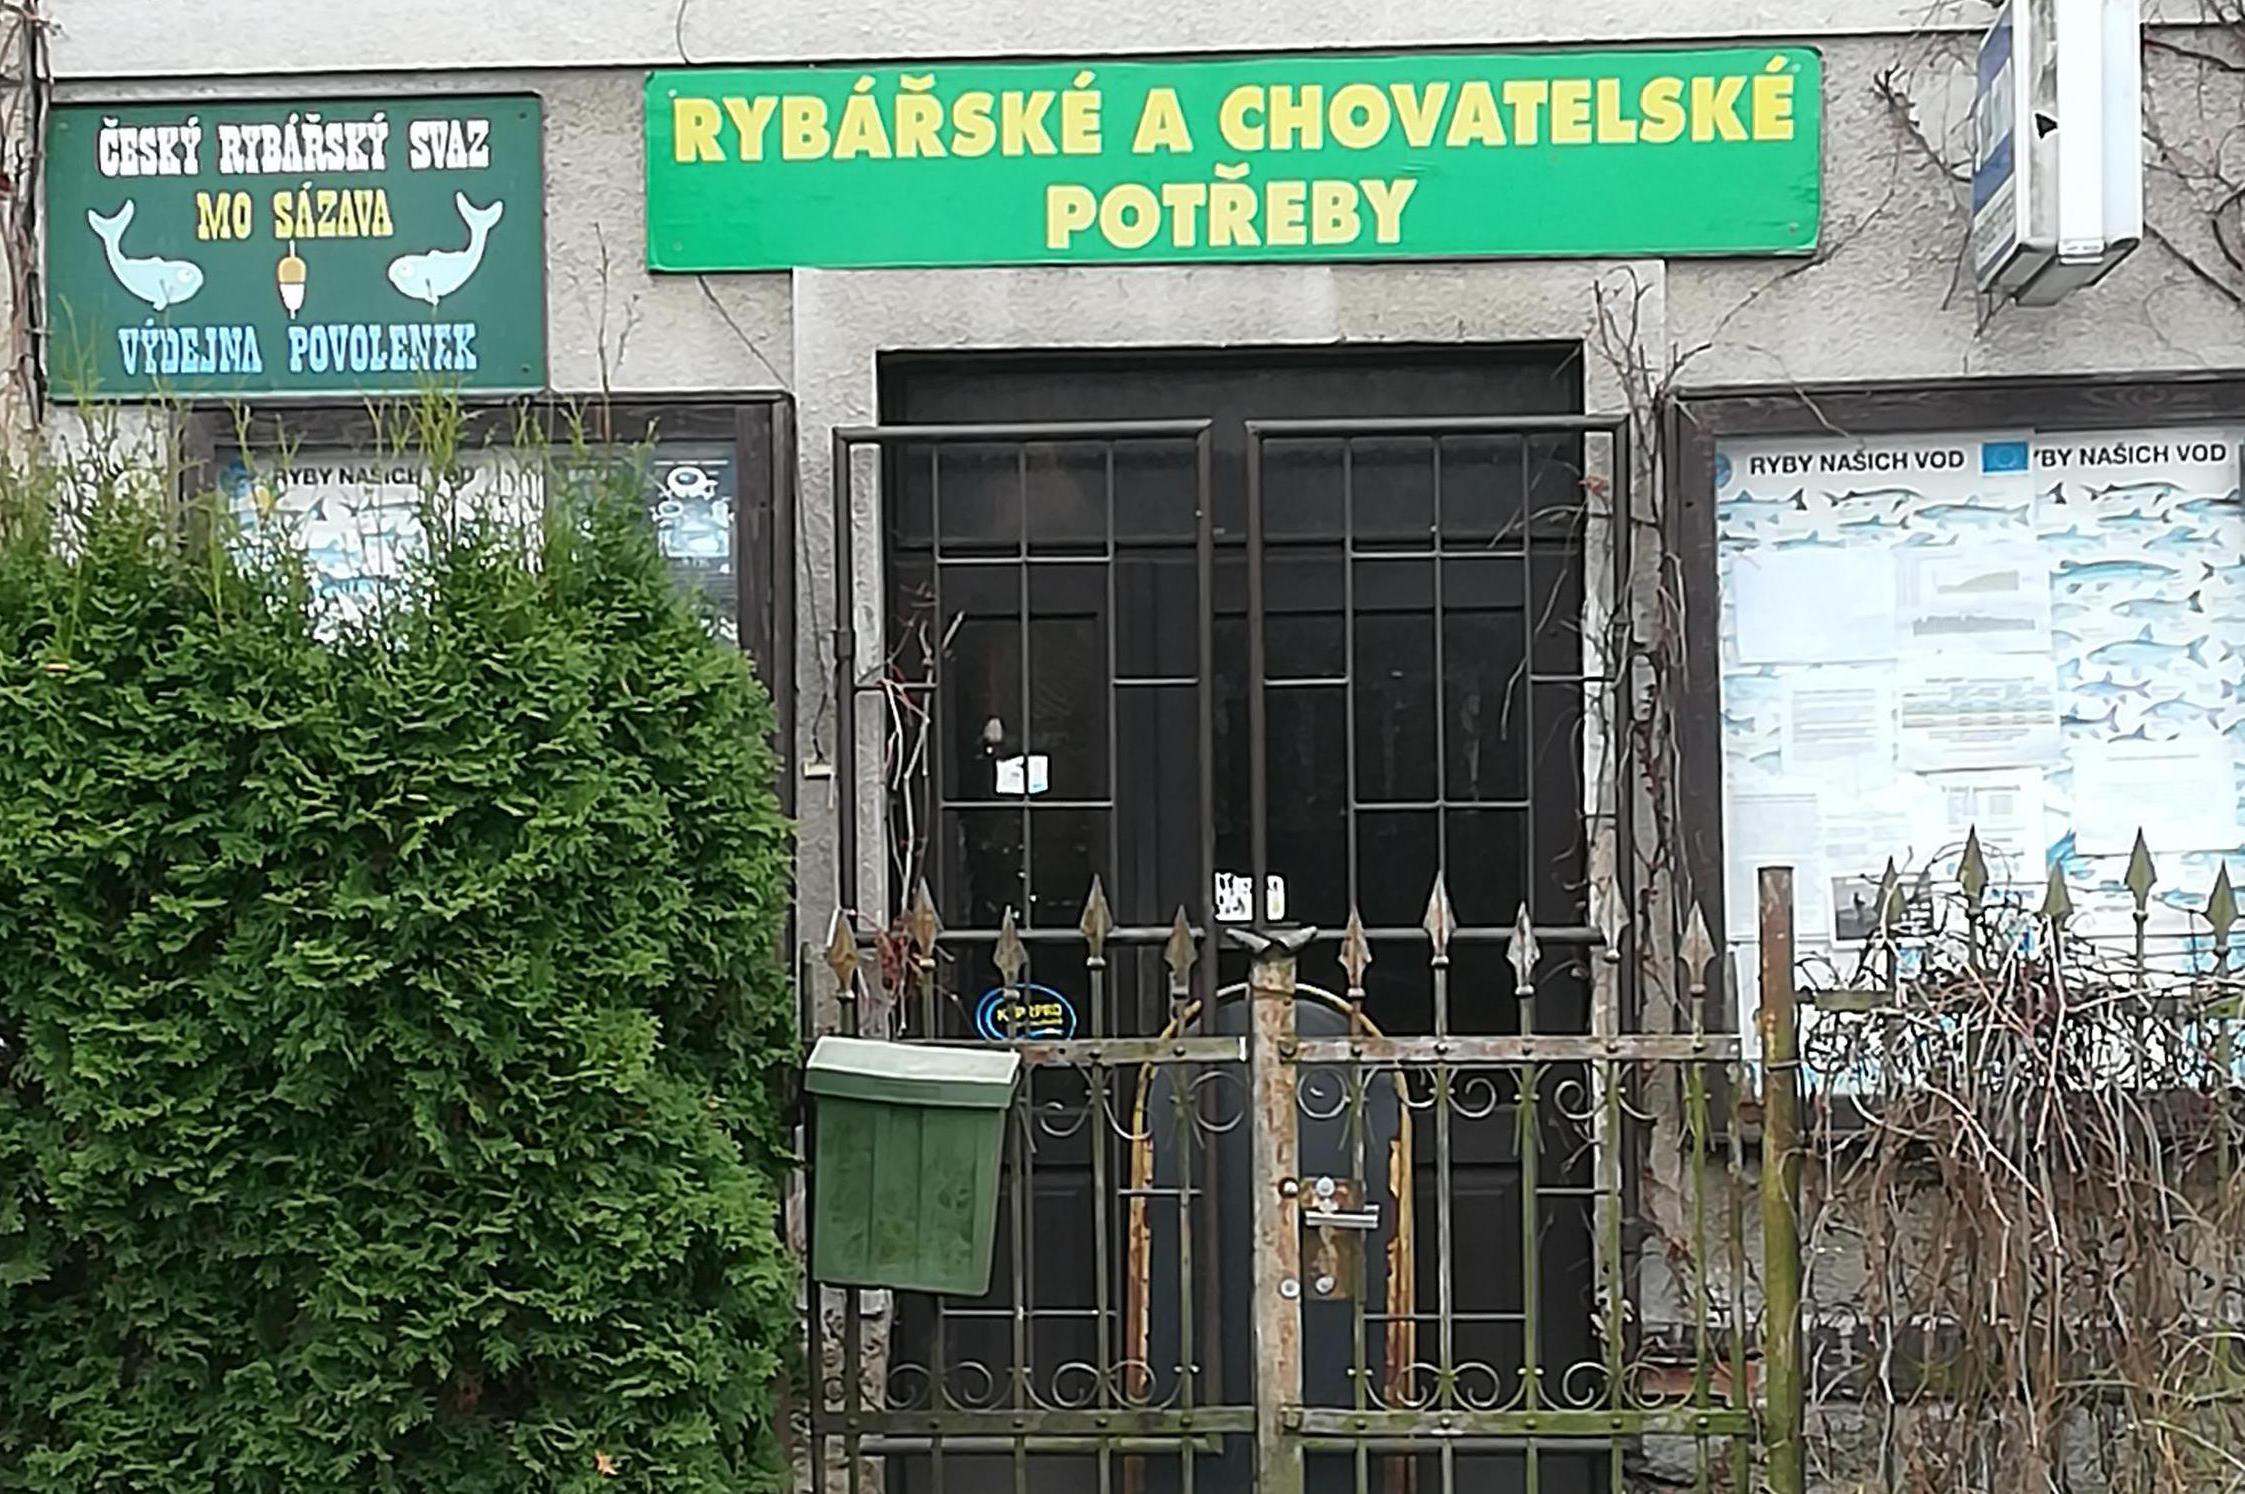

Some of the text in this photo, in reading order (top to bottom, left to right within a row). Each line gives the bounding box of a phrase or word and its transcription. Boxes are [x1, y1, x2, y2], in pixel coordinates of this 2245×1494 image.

[673, 56, 1793, 162] RYBÁŘSKÉ A CHOVATELSKÉ
[99, 113, 489, 176] ČESKÝ RYBÁŘSKÝ SVAZ
[197, 181, 393, 240] MO SÁZAVA
[1046, 162, 1416, 249] POTŘEBY
[119, 319, 477, 375] VÝDEJNA POVOLENEK
[1751, 450, 1964, 475] RYBY NAŠICH VOD
[2080, 442, 2169, 466] NAŠICH
[2177, 444, 2226, 462] VOD
